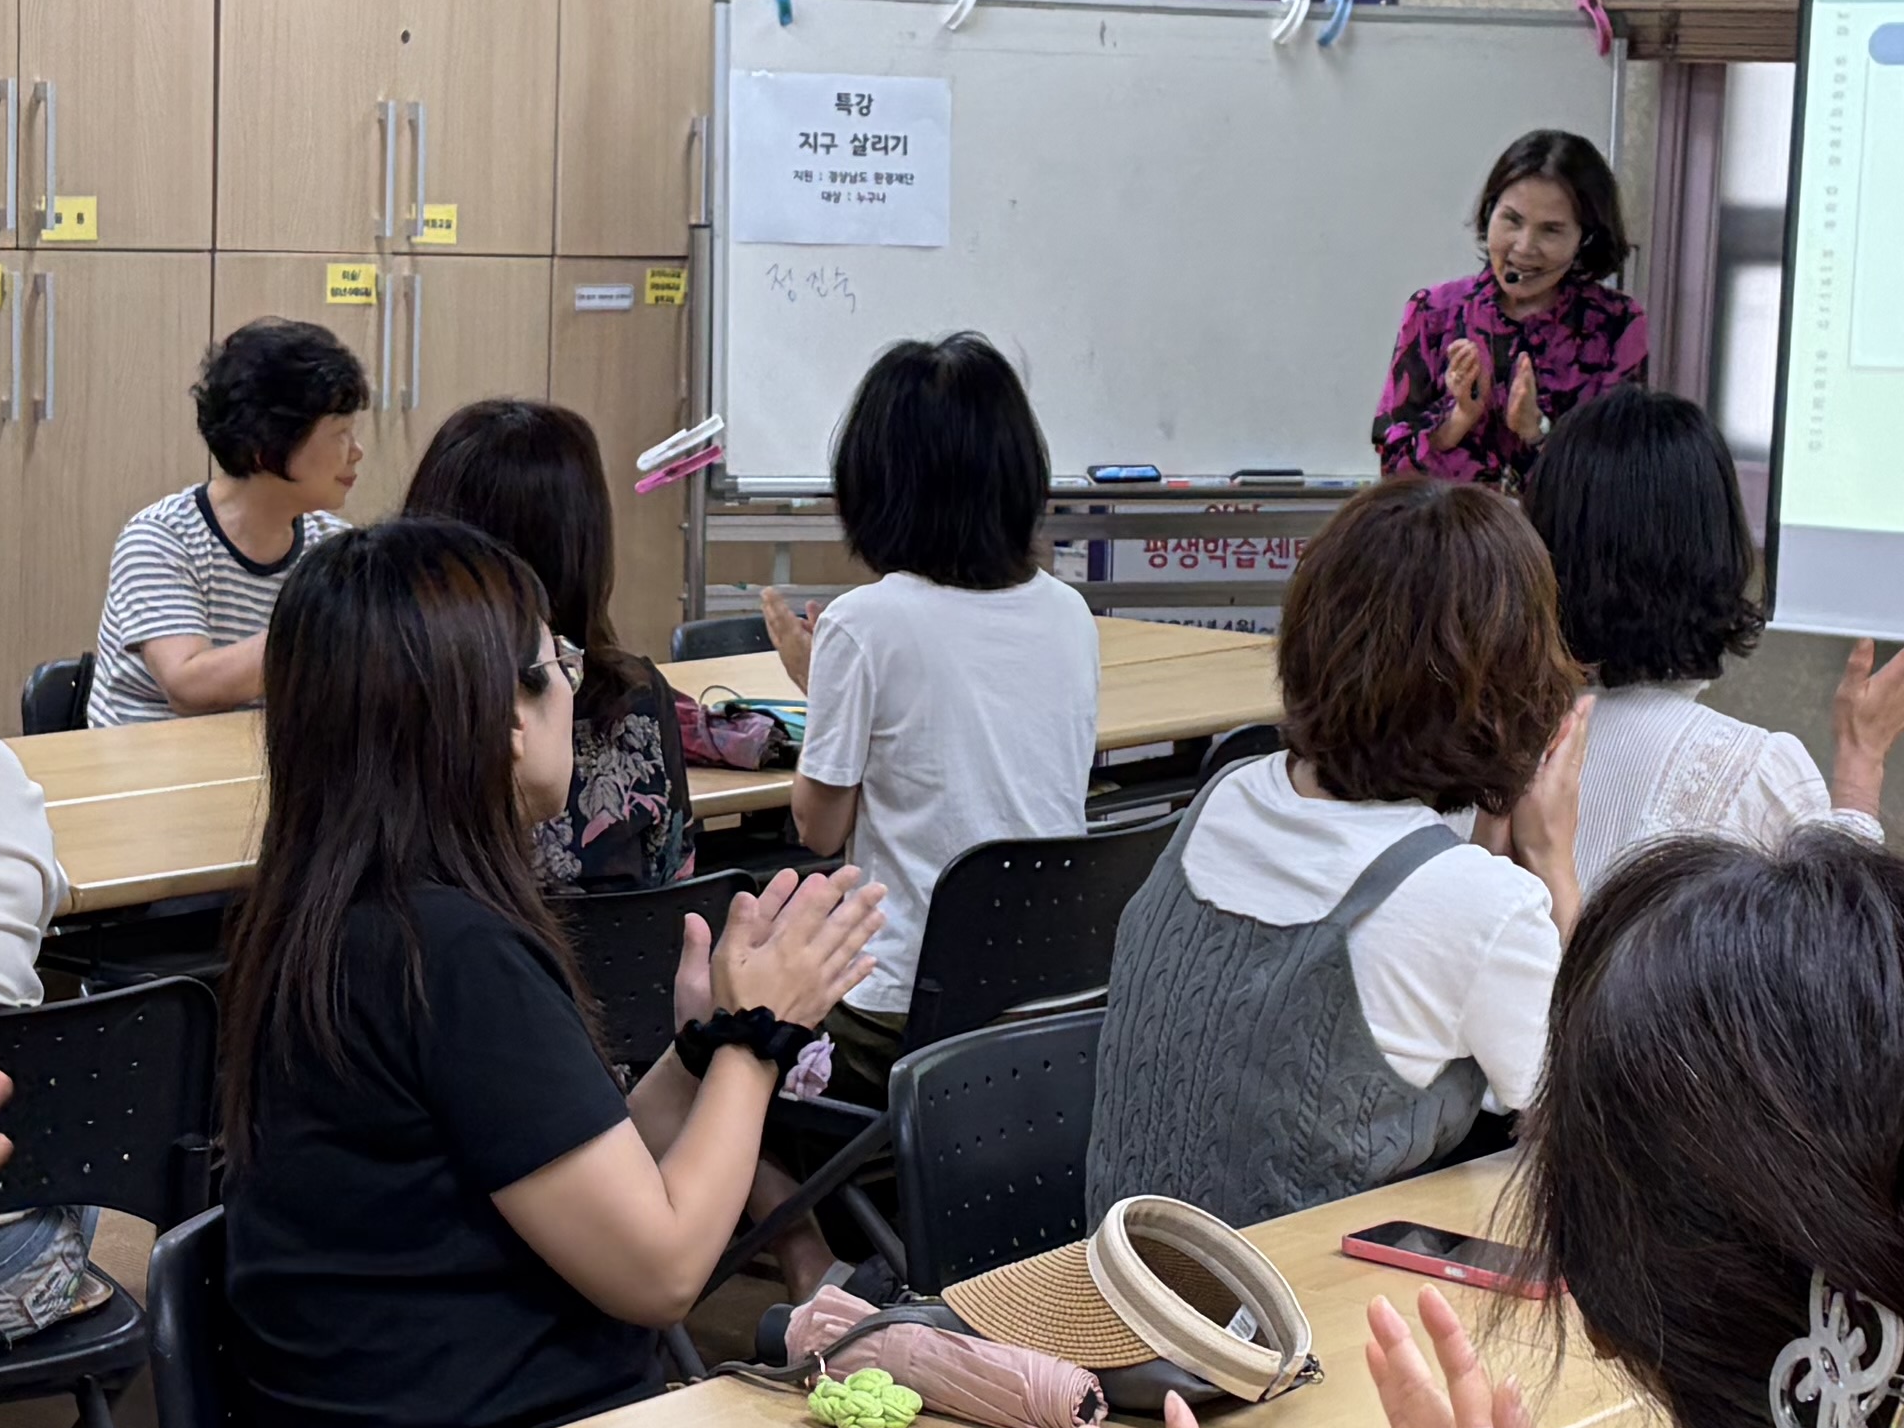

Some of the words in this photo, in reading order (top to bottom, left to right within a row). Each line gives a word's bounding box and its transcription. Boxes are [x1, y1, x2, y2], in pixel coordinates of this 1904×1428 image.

[834, 92, 874, 117] 특강
[798, 131, 839, 156] 지구
[849, 132, 908, 157] 살리기
